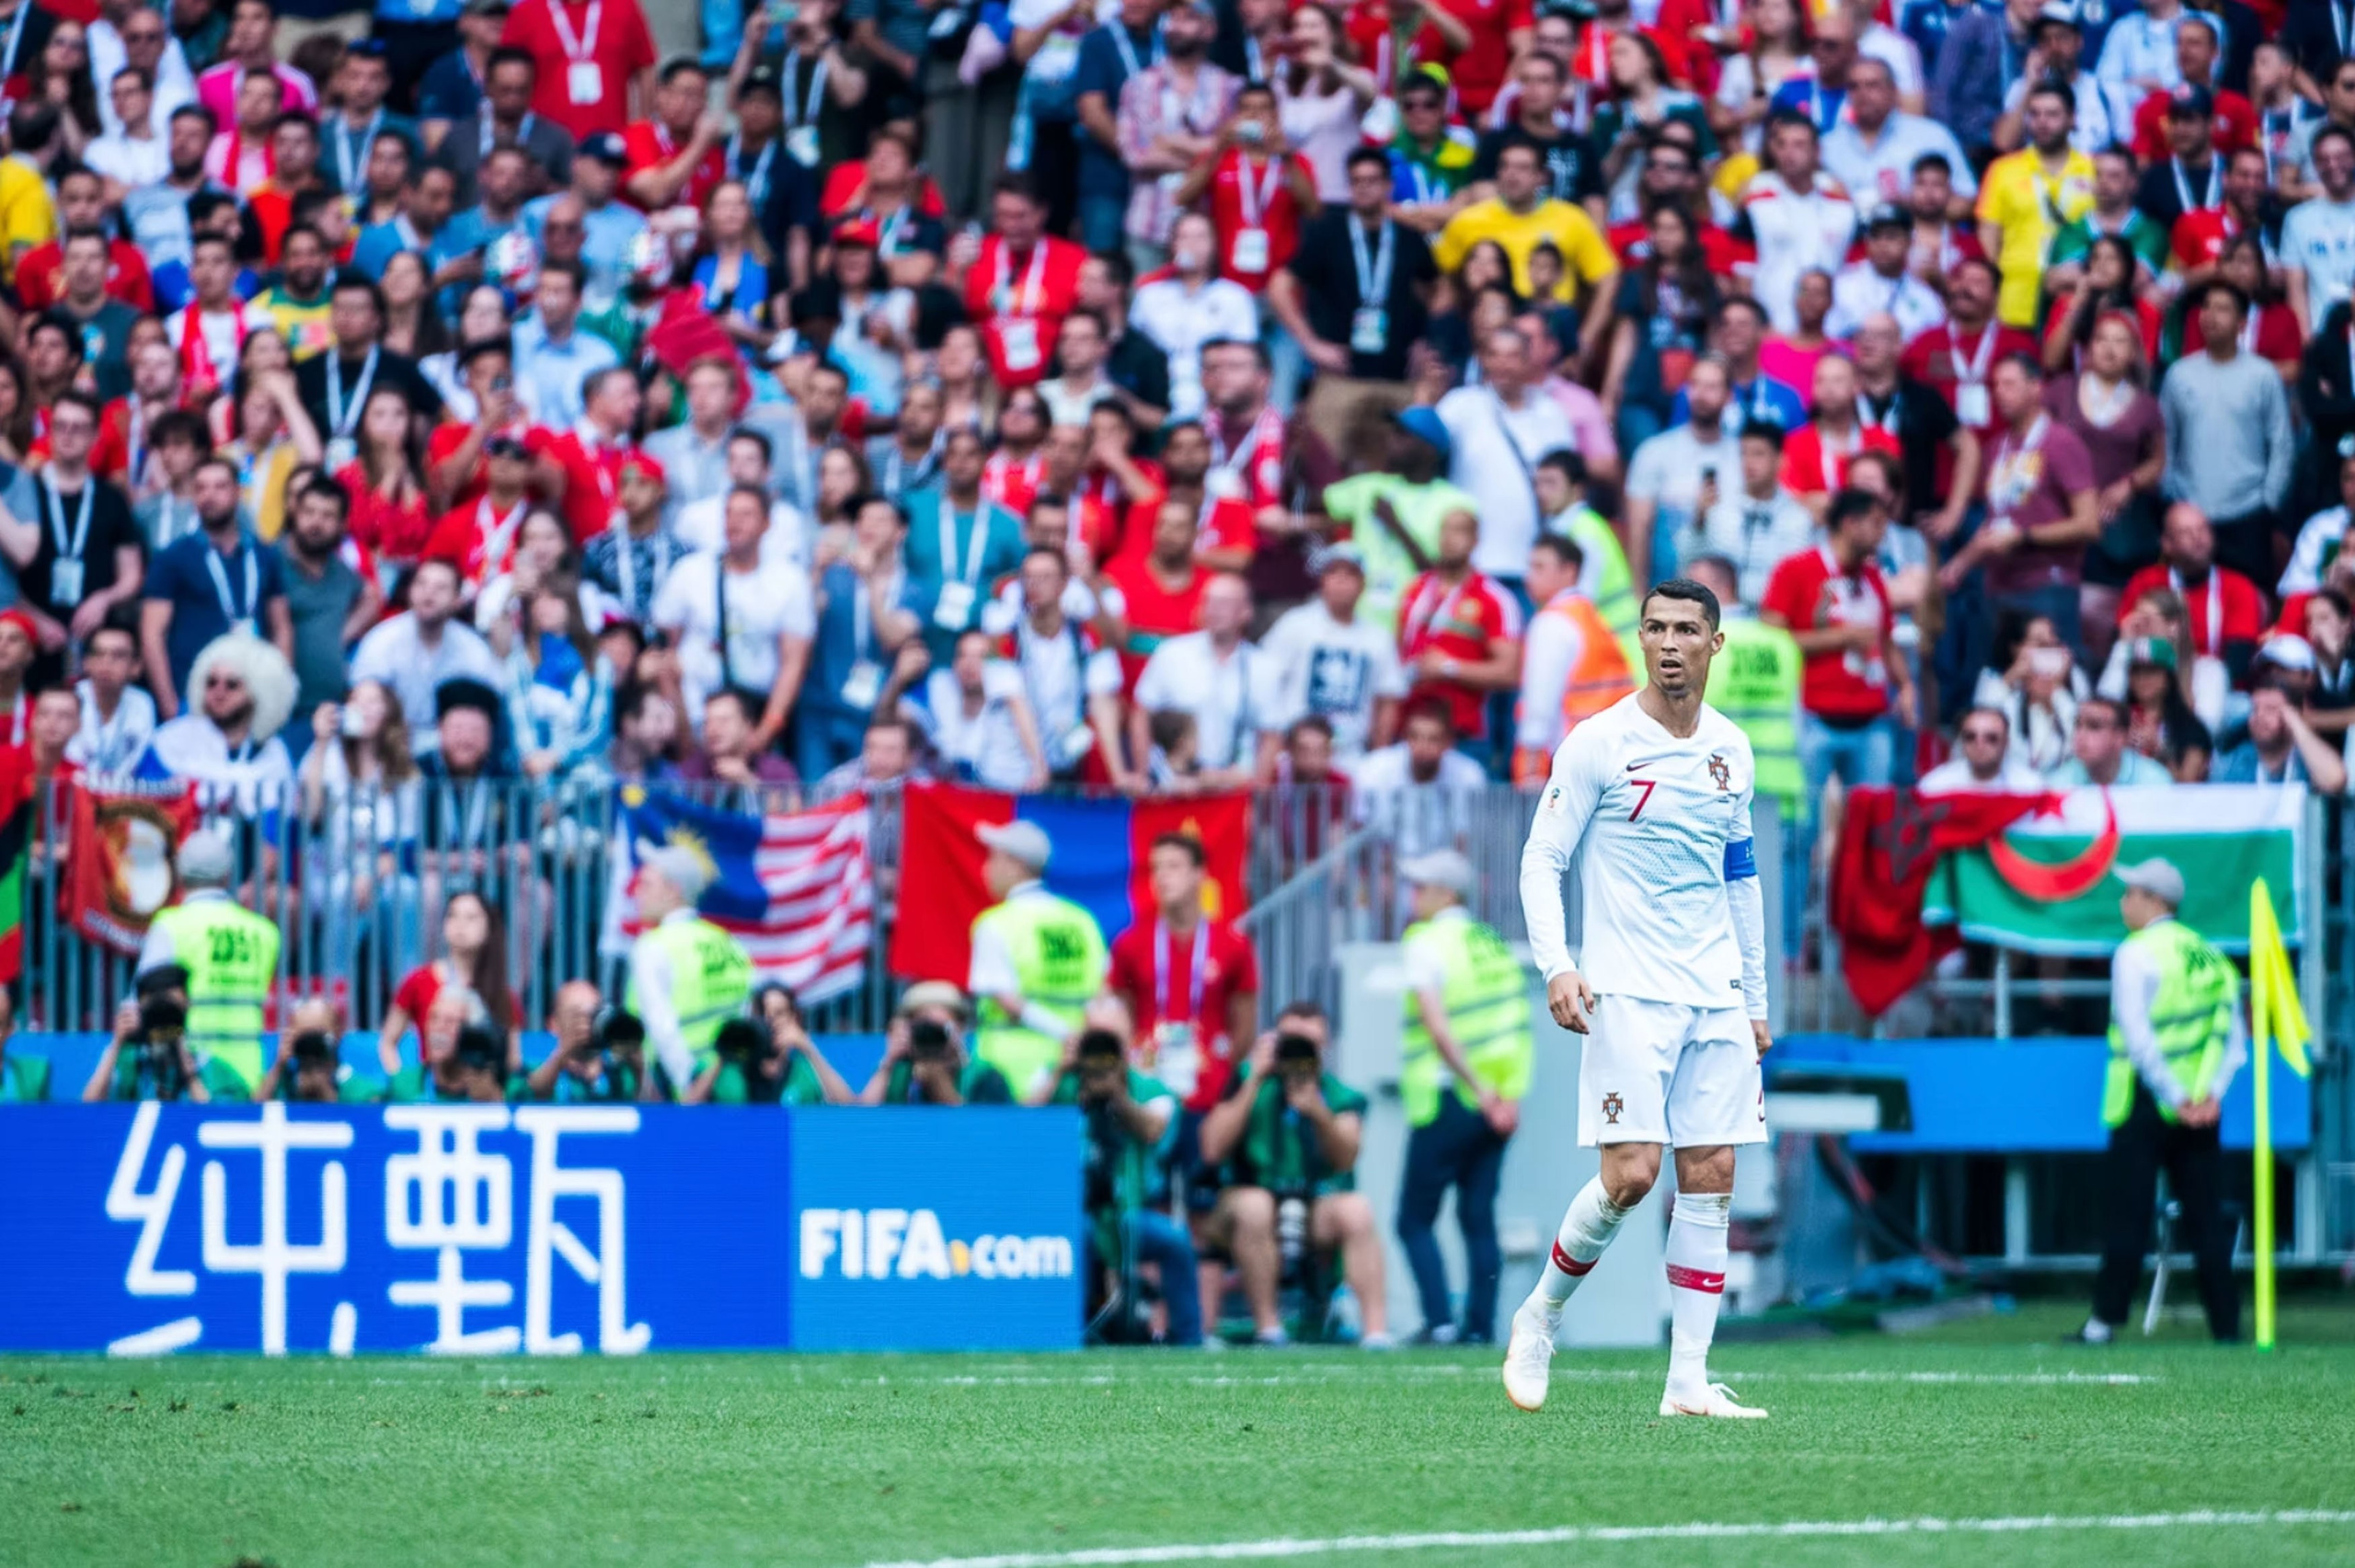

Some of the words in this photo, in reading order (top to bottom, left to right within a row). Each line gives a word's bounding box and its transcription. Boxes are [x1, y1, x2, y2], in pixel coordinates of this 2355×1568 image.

[1627, 780, 1656, 822] 7
[105, 1100, 651, 1356] 纯甄
[800, 1207, 1073, 1279] FIFA.com
